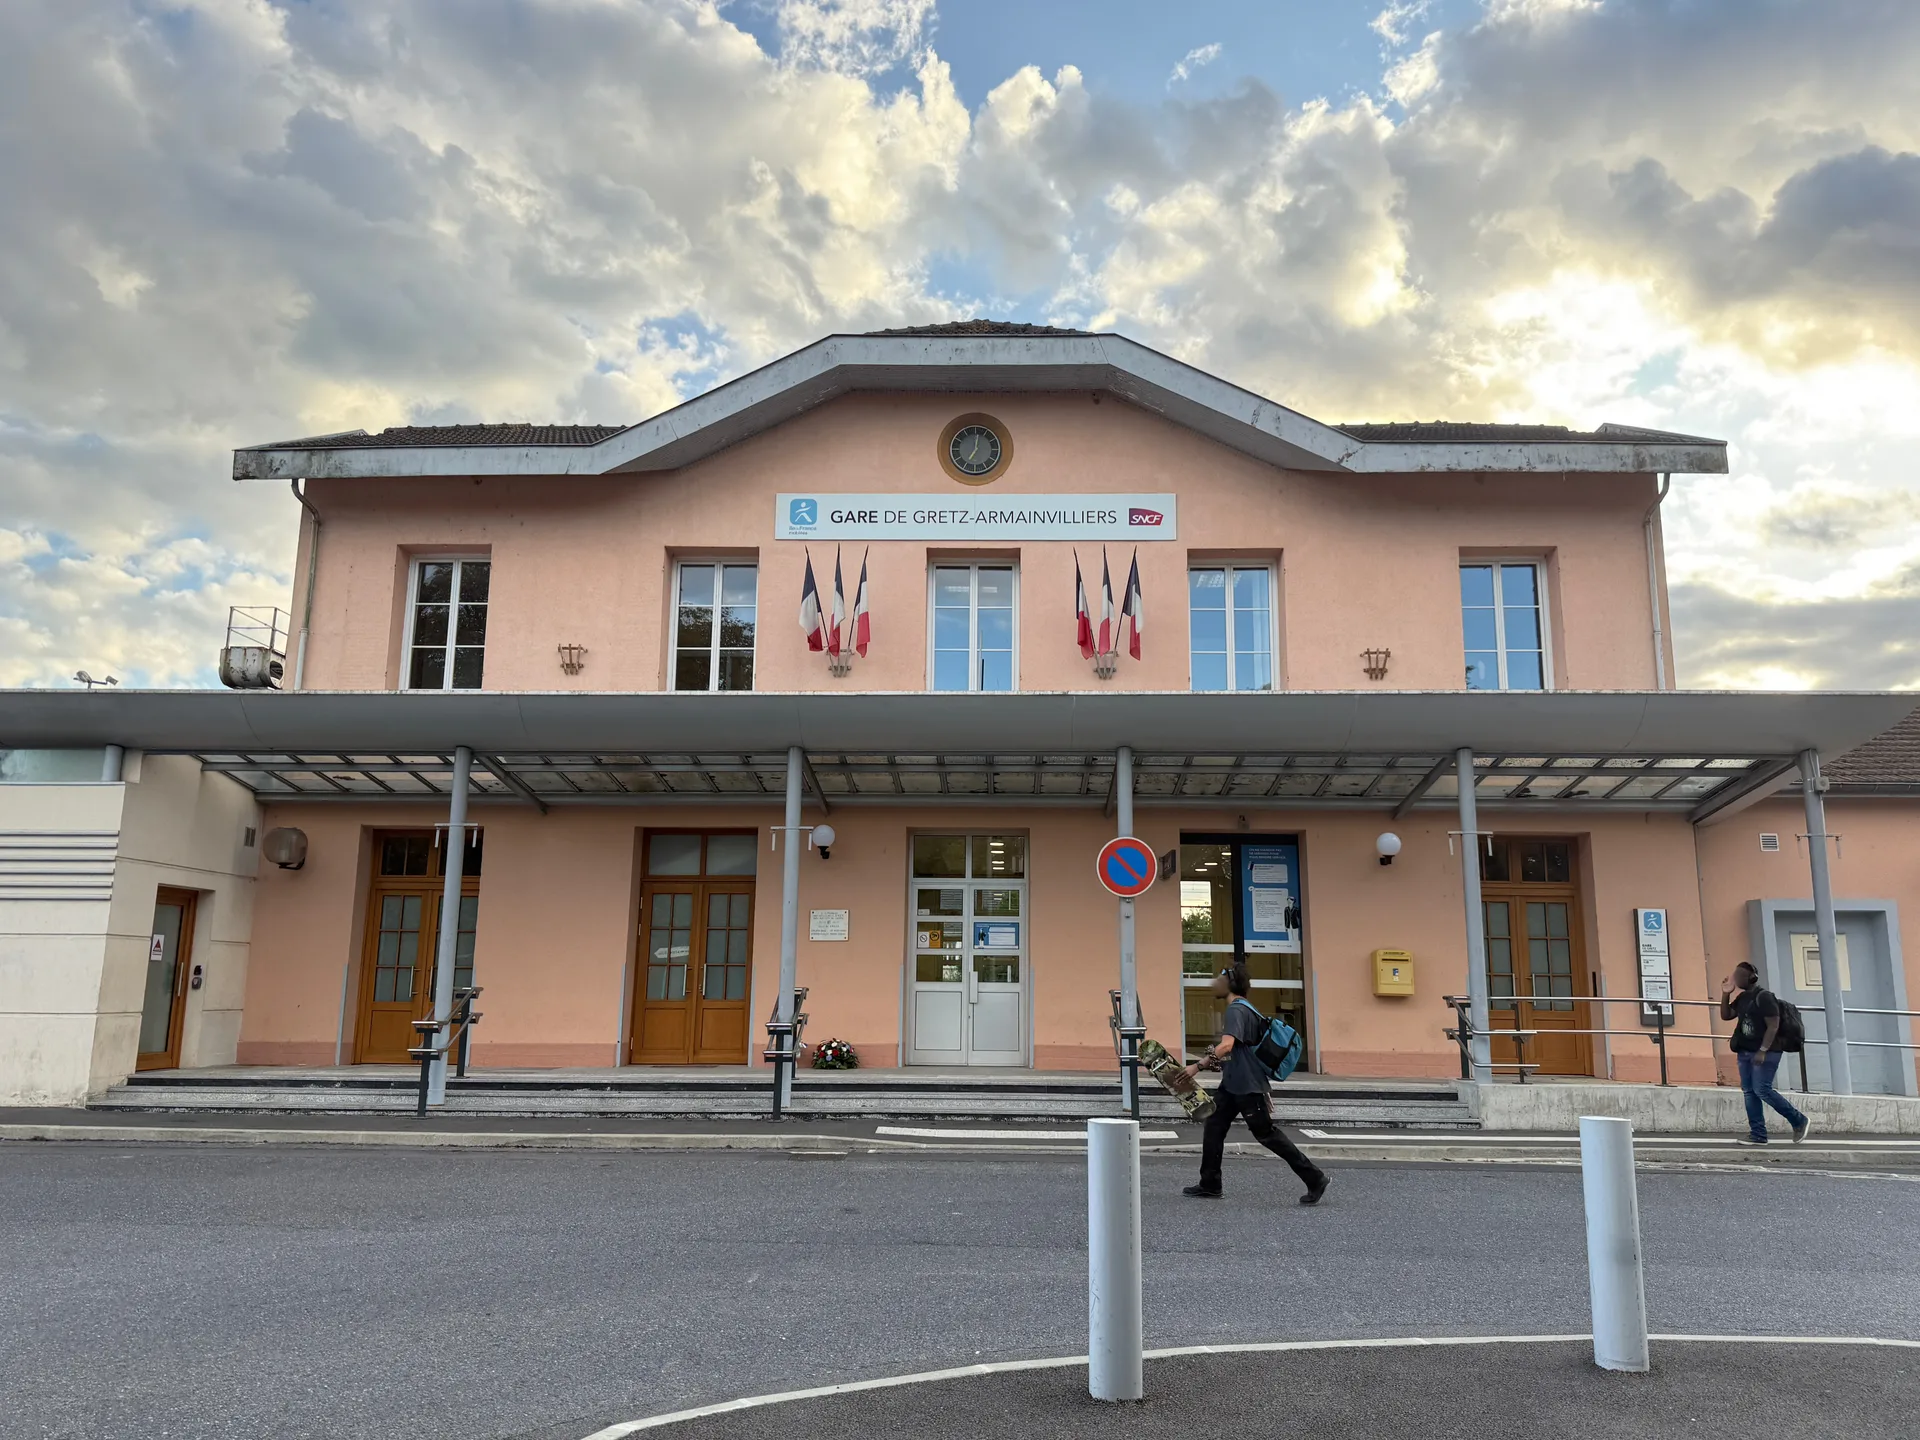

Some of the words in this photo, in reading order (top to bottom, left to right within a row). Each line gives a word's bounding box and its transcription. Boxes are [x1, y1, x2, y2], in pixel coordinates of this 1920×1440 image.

[830, 510, 879, 524] GARE
[884, 510, 907, 524] DE
[913, 510, 1118, 524] GRETZ-ARMAINVILLIERS
[1130, 514, 1162, 524] SNCF
